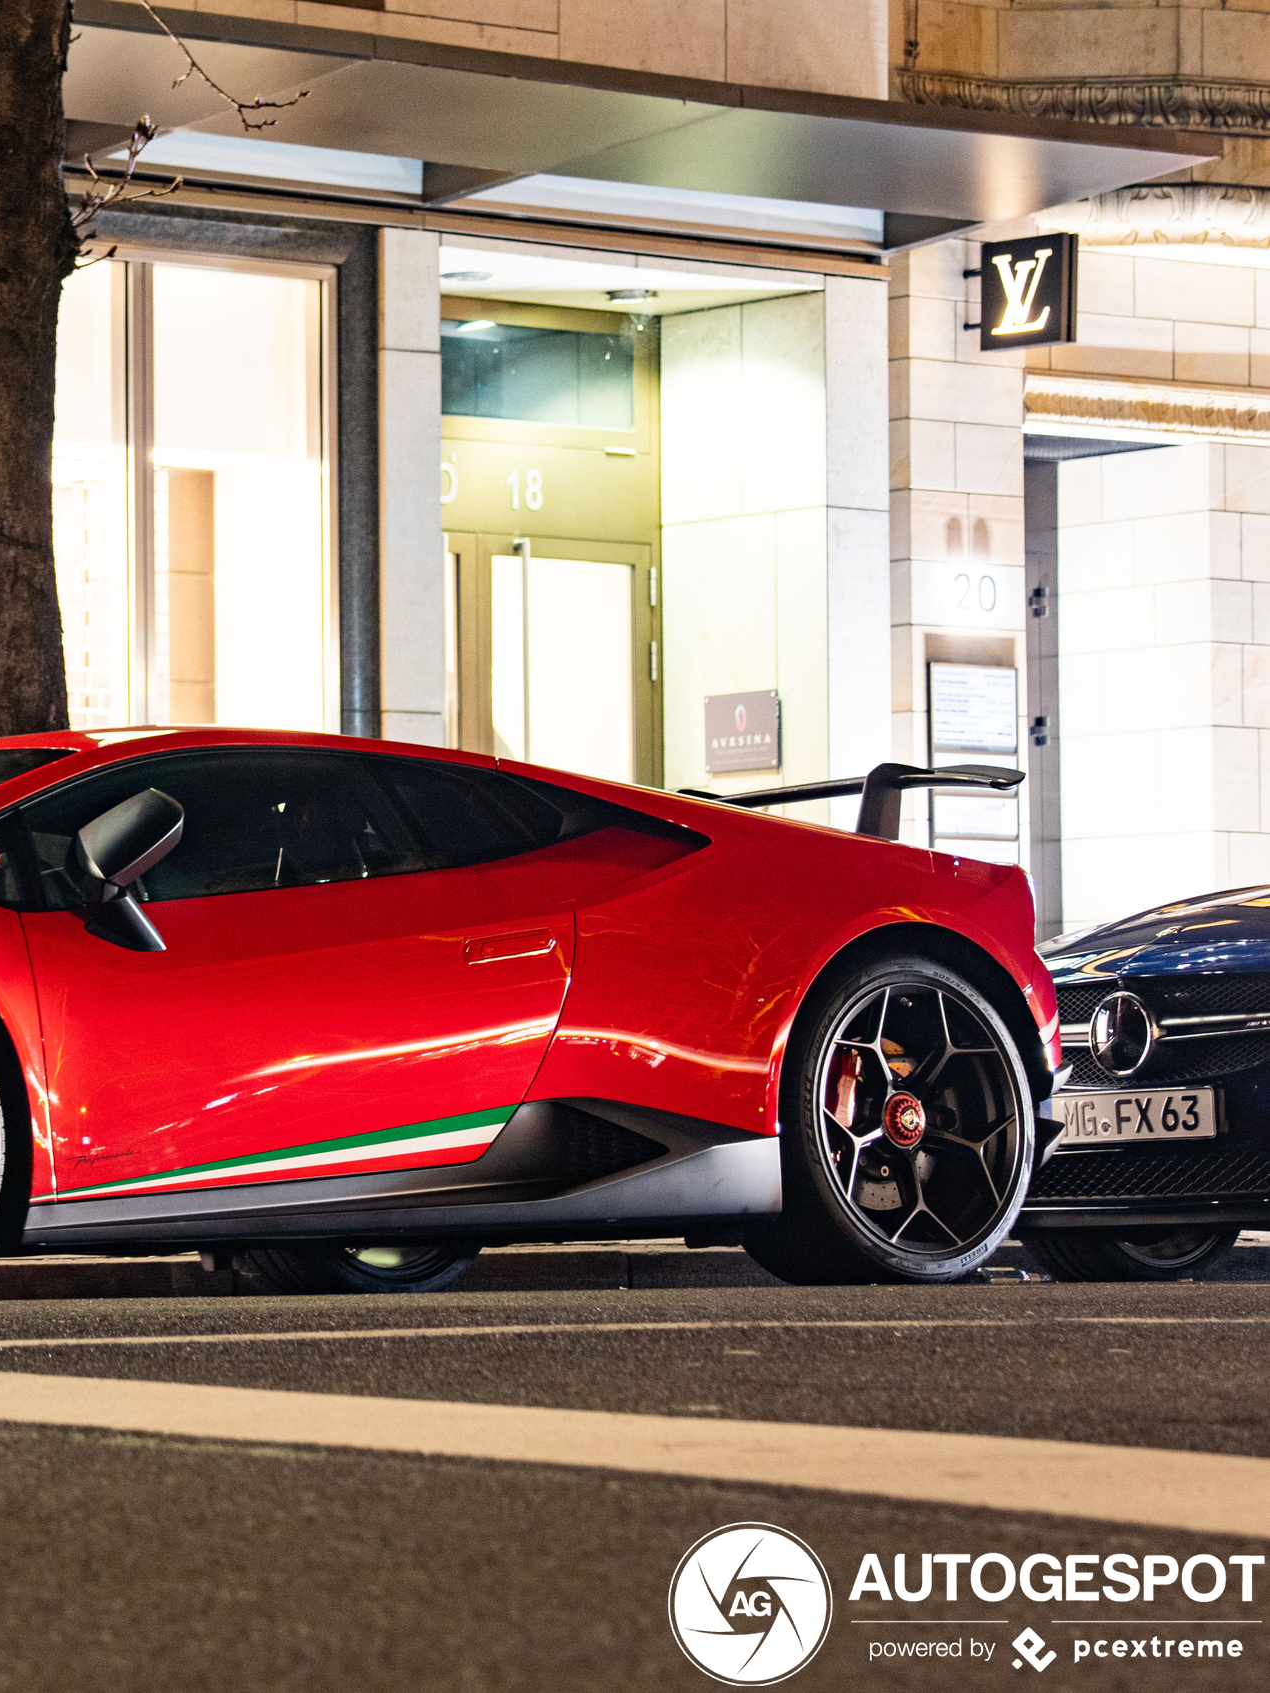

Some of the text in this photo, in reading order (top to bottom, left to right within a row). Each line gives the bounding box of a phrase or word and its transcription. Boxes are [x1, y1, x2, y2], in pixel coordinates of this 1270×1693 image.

[505, 468, 543, 512] 18
[954, 573, 997, 612] 20
[711, 733, 771, 749] AVESINA
[1061, 1101, 1098, 1136] MG
